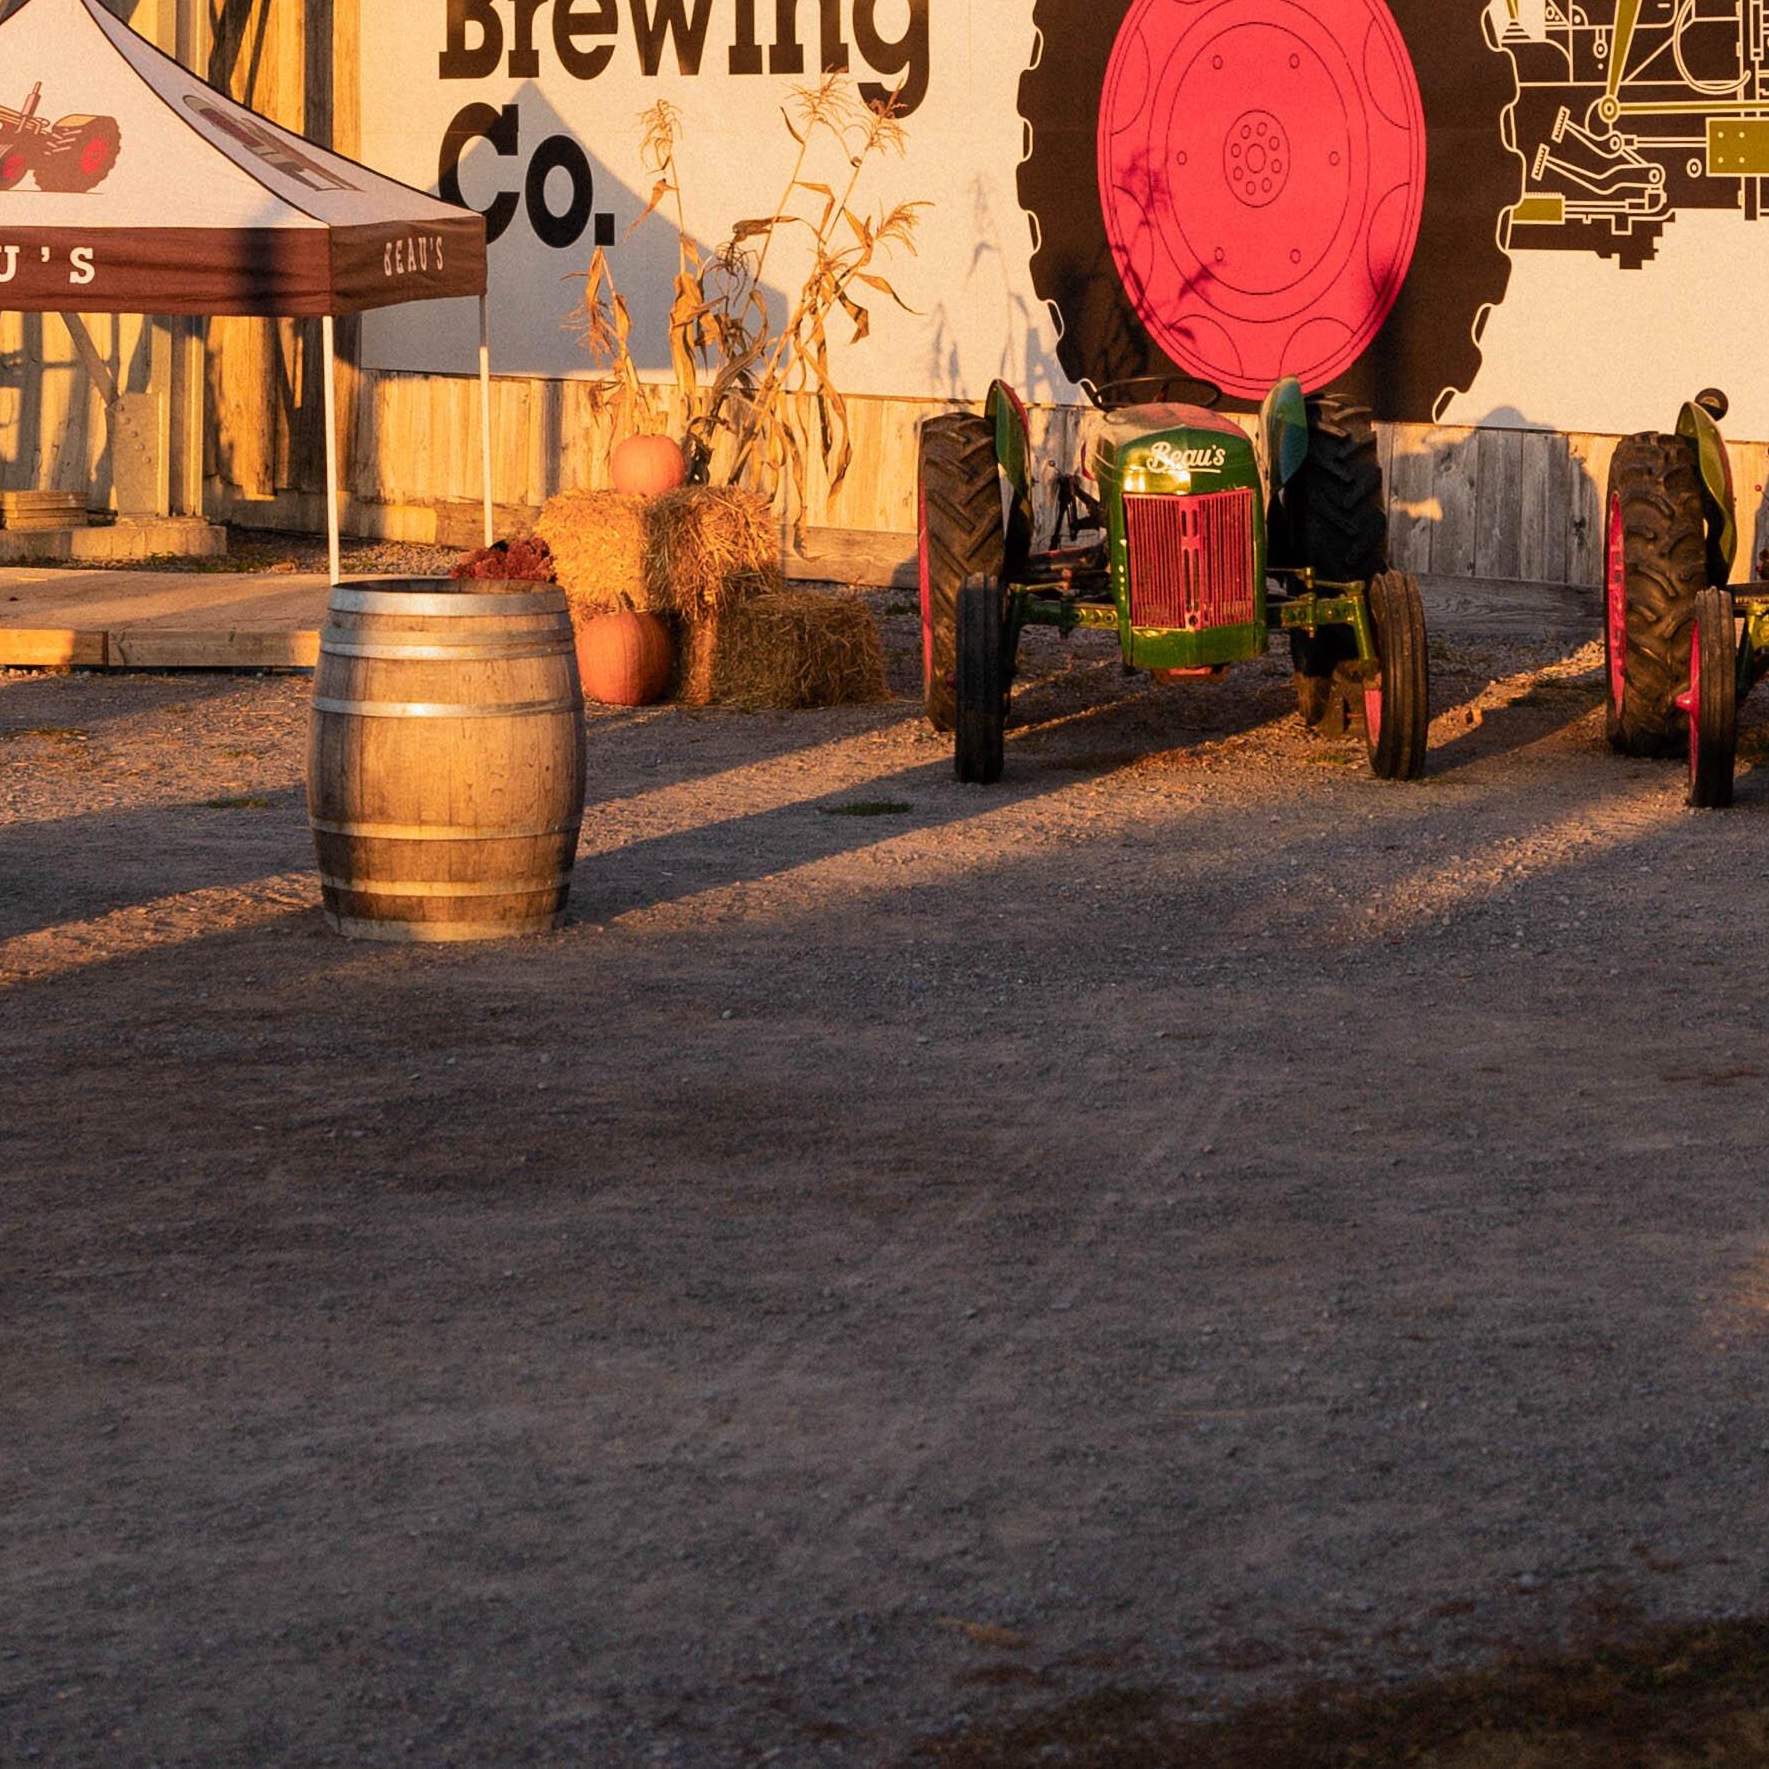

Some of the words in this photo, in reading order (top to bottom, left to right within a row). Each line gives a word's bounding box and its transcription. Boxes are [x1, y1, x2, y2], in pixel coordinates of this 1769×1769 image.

[438, 102, 616, 248] Co.
[383, 236, 444, 277] BEAU'S
[1146, 441, 1226, 473] Beau's
